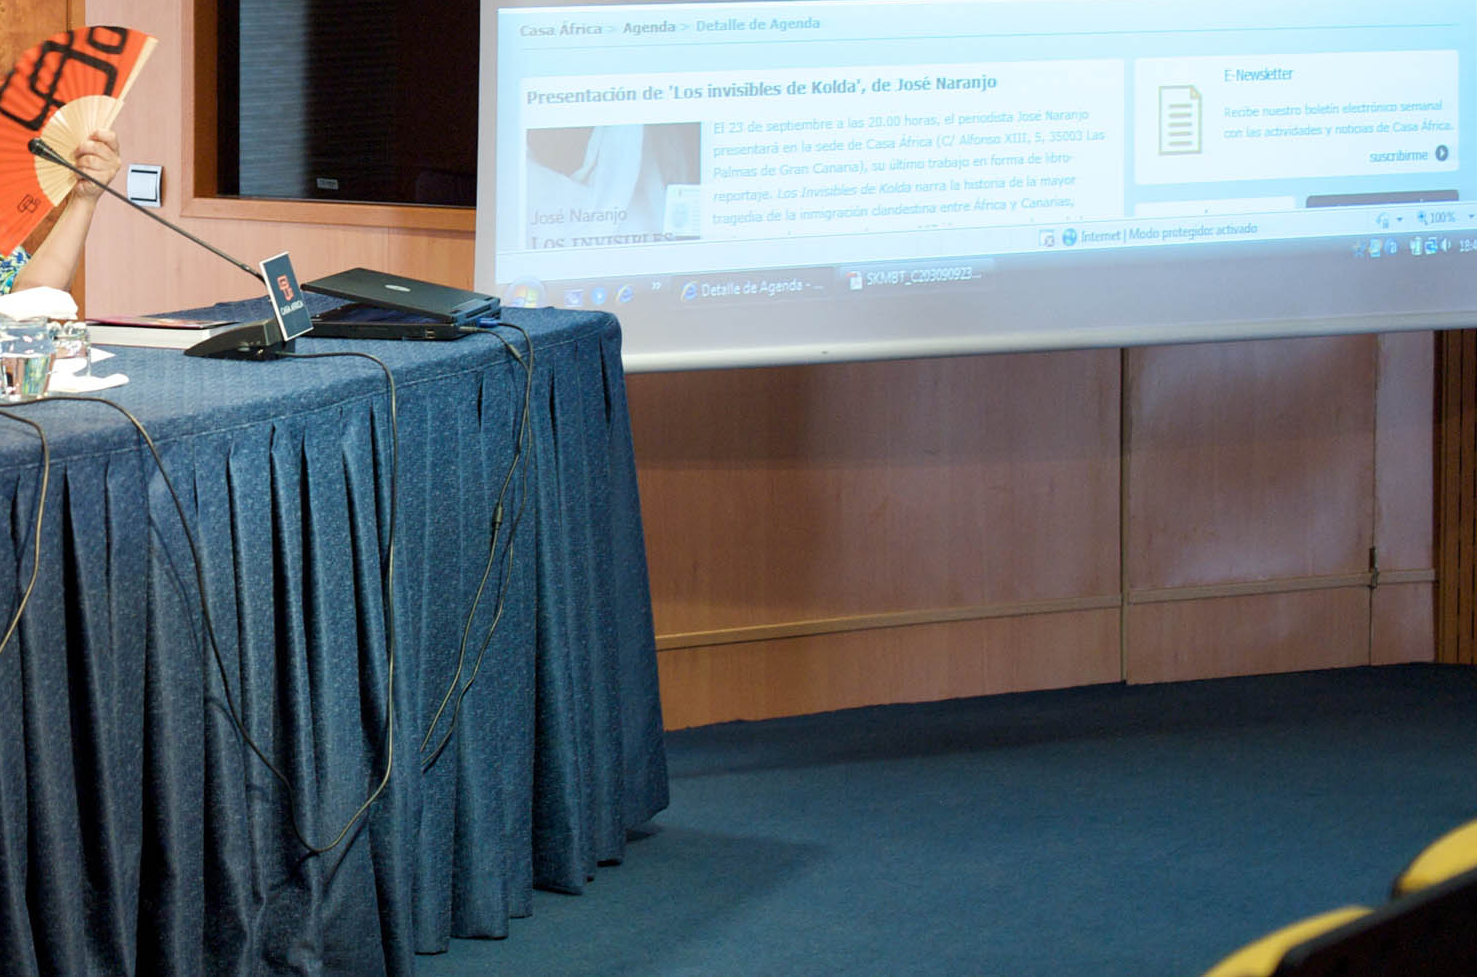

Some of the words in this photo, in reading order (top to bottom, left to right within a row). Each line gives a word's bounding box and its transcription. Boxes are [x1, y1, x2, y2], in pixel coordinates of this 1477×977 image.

[520, 24, 556, 38] Casa
[559, 20, 603, 37] África
[623, 21, 676, 36] Agenda
[696, 19, 745, 34] Detalle
[749, 18, 767, 32] de
[770, 17, 821, 33] Agenda
[1224, 68, 1295, 83] E-Newsletter
[526, 86, 637, 105] Presentación
[642, 85, 664, 101] de
[668, 84, 703, 100] 'Los
[707, 81, 782, 99] invisibles
[787, 79, 807, 95] de
[811, 78, 867, 95] Kolda',
[871, 77, 892, 92] de
[897, 75, 931, 92] José
[935, 74, 998, 93] Naranjo
[747, 120, 764, 134] de
[1045, 108, 1090, 123] Naranjo
[866, 137, 896, 150] Casa
[1369, 149, 1429, 163] suscribirme
[531, 208, 565, 225] José
[569, 207, 628, 225] Naranjo
[1081, 230, 1121, 244] Internet
[1128, 227, 1160, 240] Modo
[1215, 221, 1260, 235] activado
[701, 282, 741, 298] Detalle
[744, 281, 757, 295] de
[759, 279, 803, 298] Agenda
